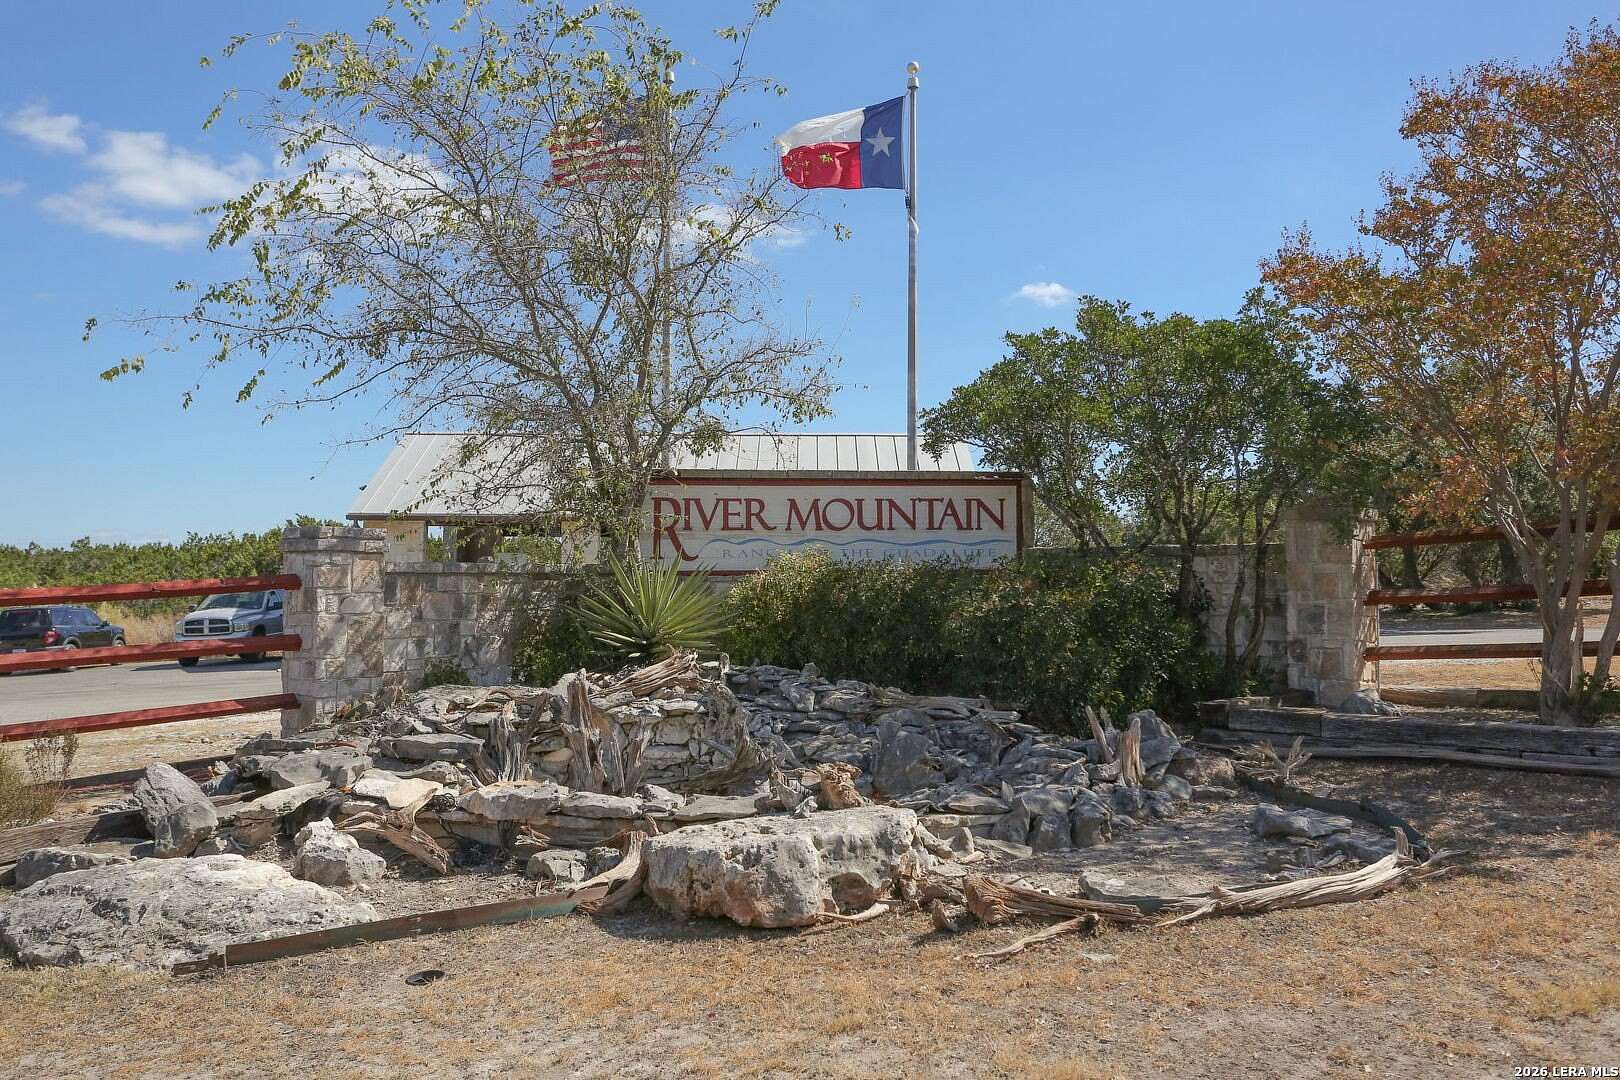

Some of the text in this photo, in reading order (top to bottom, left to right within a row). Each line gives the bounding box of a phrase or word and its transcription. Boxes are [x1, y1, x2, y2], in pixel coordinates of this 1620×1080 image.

[651, 496, 1006, 561] RIVER MOUNTAIN
[839, 548, 877, 560] THE
